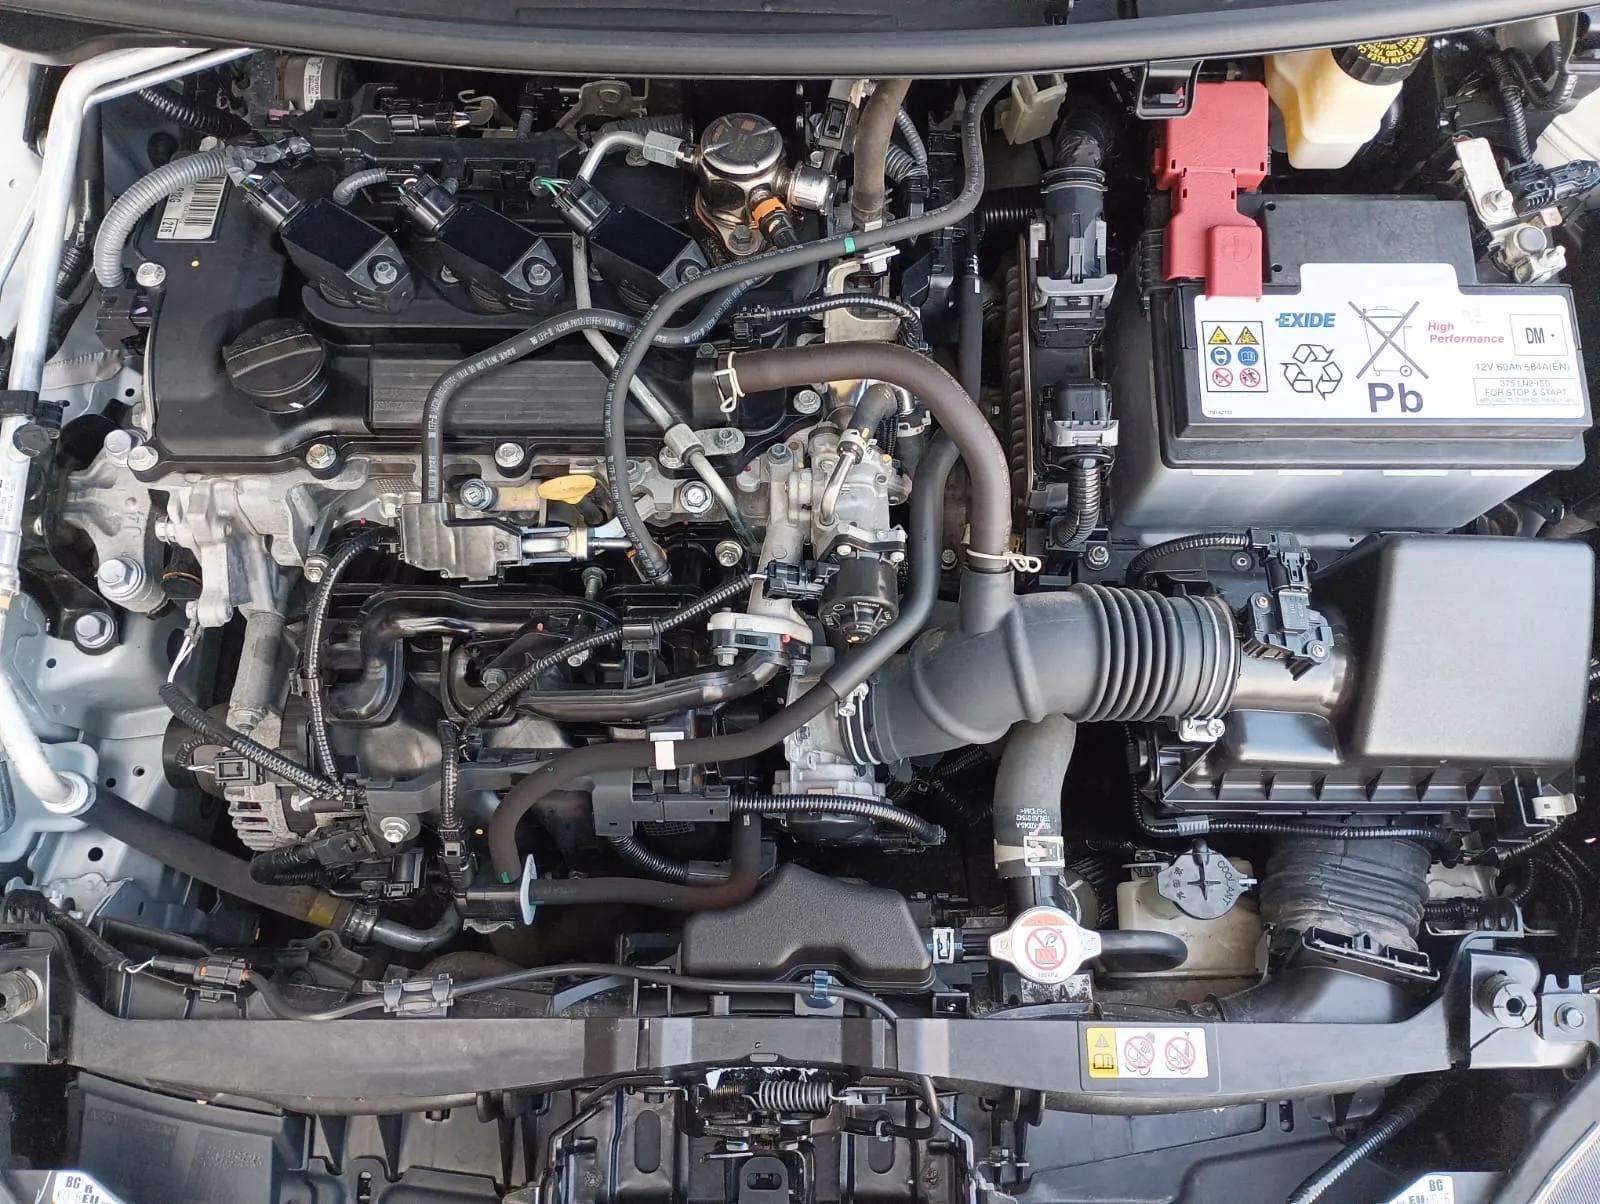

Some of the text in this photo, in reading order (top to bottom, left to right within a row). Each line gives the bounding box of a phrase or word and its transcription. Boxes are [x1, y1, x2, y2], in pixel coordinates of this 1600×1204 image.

[1391, 53, 1413, 64] CLEAN
[160, 221, 174, 233] 216
[1277, 313, 1336, 328] EXIDE
[1428, 321, 1455, 333] High
[1430, 334, 1504, 344] Performance
[1526, 328, 1546, 344] DM
[1476, 363, 1494, 371] 12V
[1368, 382, 1424, 413] Pb
[1541, 388, 1567, 396] START
[1217, 860, 1235, 906] COOLANT
[65, 1175, 82, 1189] BG
[1428, 1179, 1444, 1192] BG
